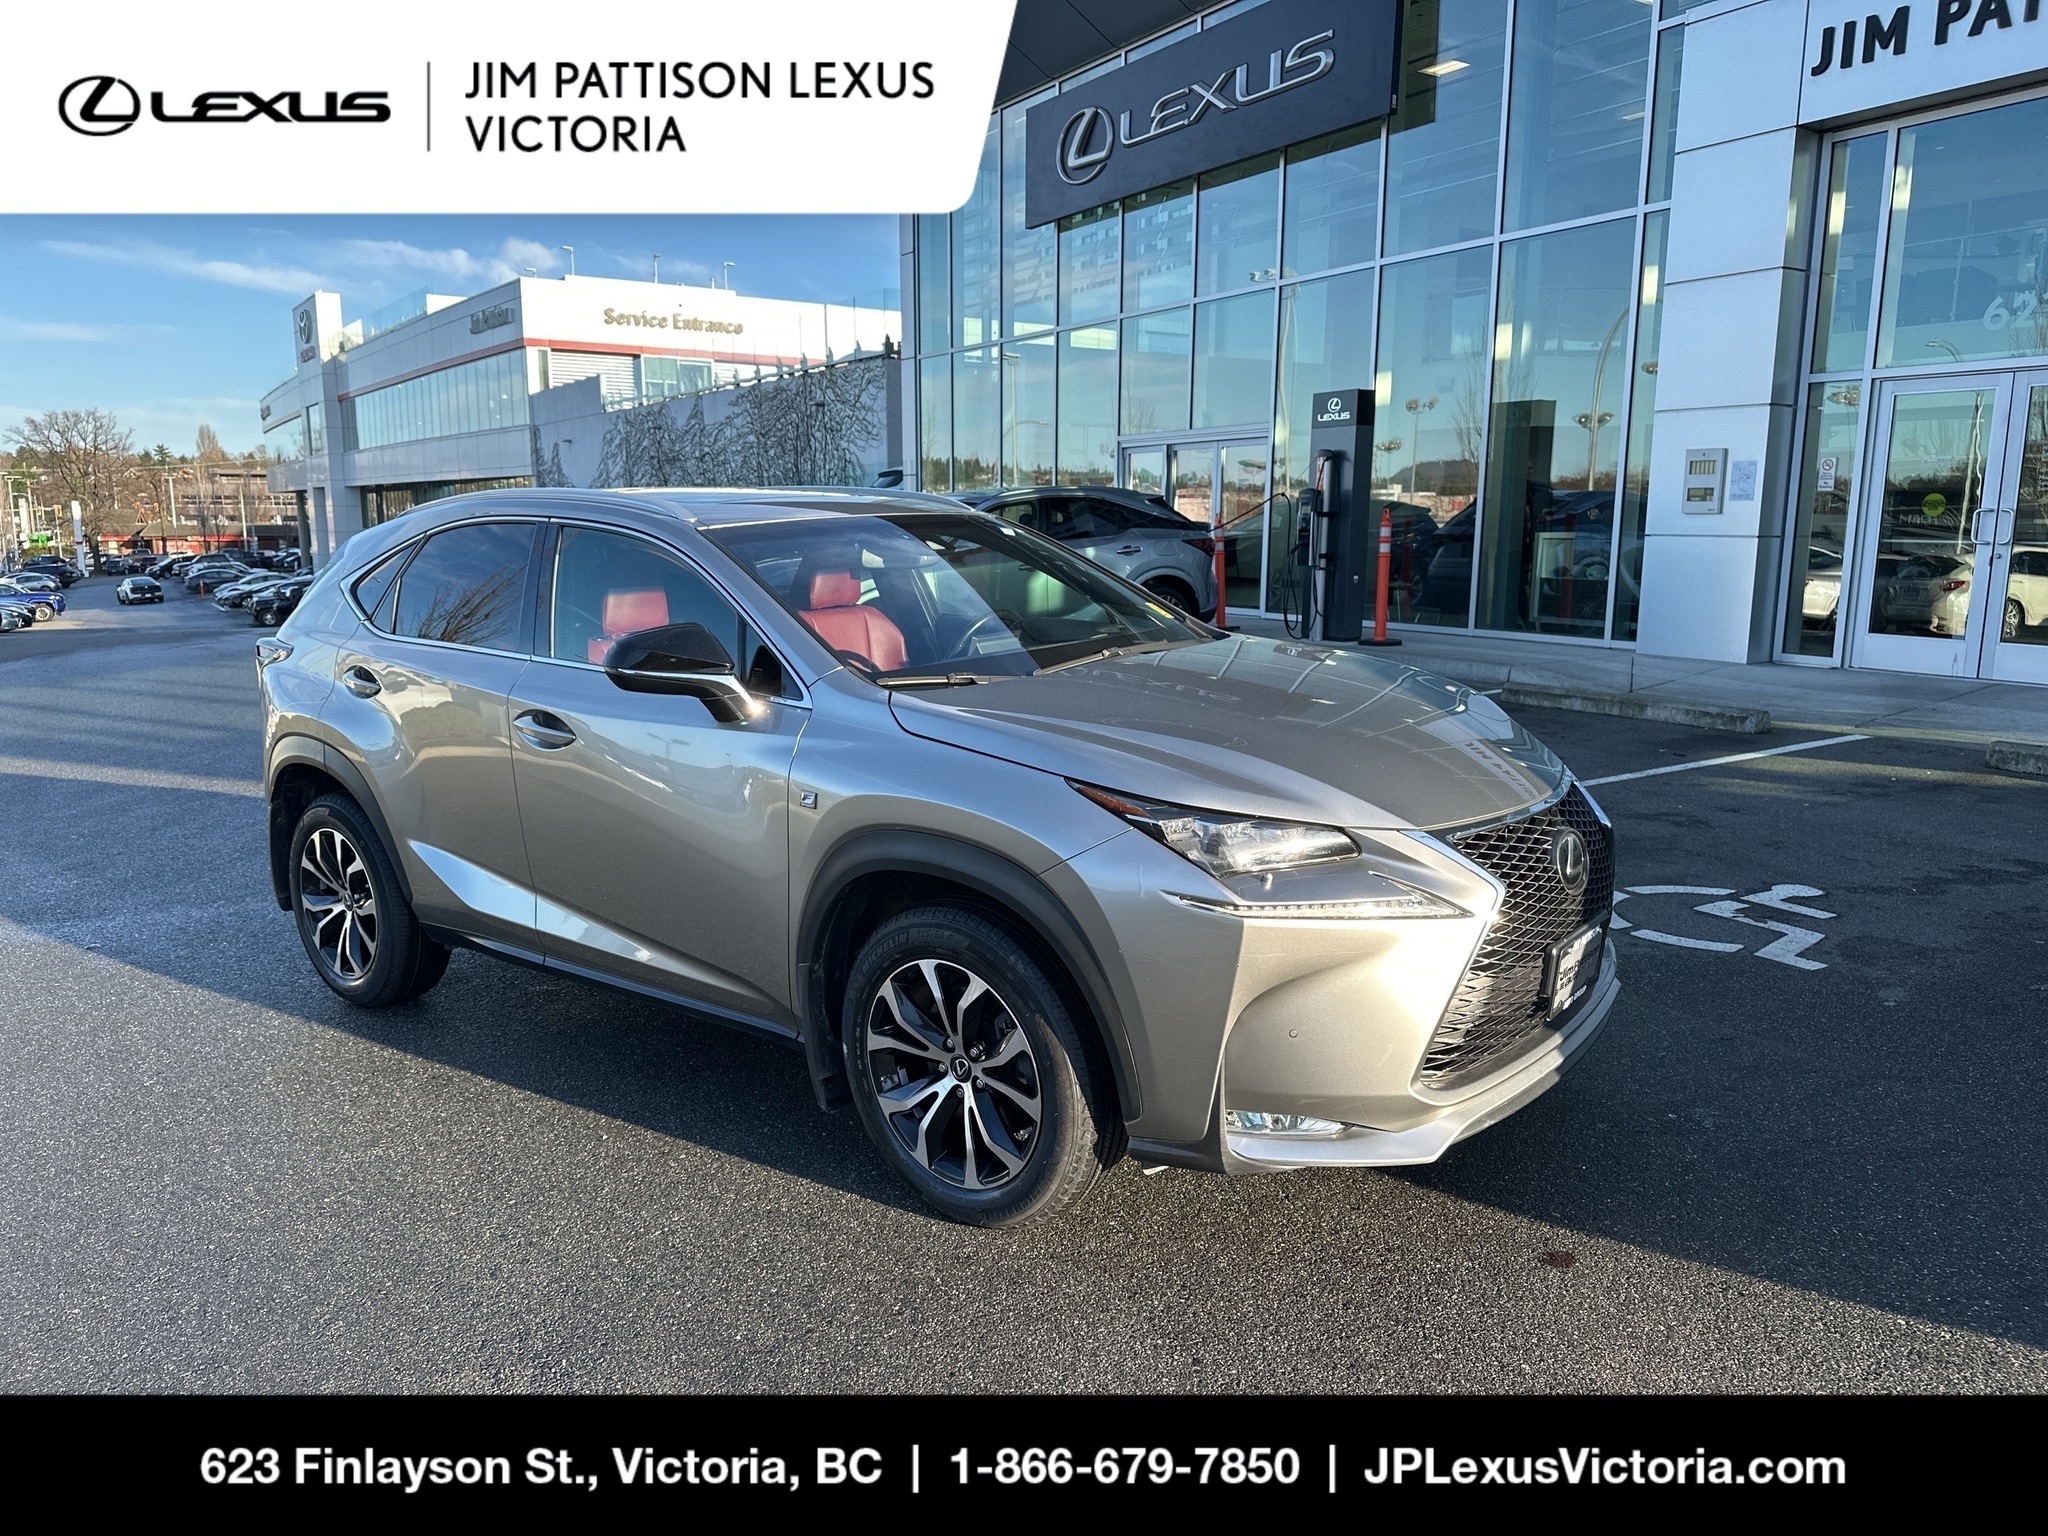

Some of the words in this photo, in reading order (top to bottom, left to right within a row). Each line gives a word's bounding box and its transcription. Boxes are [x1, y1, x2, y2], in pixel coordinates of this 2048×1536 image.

[1810, 4, 1911, 77] JIM
[1120, 28, 1335, 148] LEXUS
[603, 307, 669, 329] Service
[672, 312, 745, 335] Entrance
[1982, 290, 2048, 331] 62
[1317, 411, 1351, 422] LEXUS
[861, 931, 908, 974] MICHELIN
